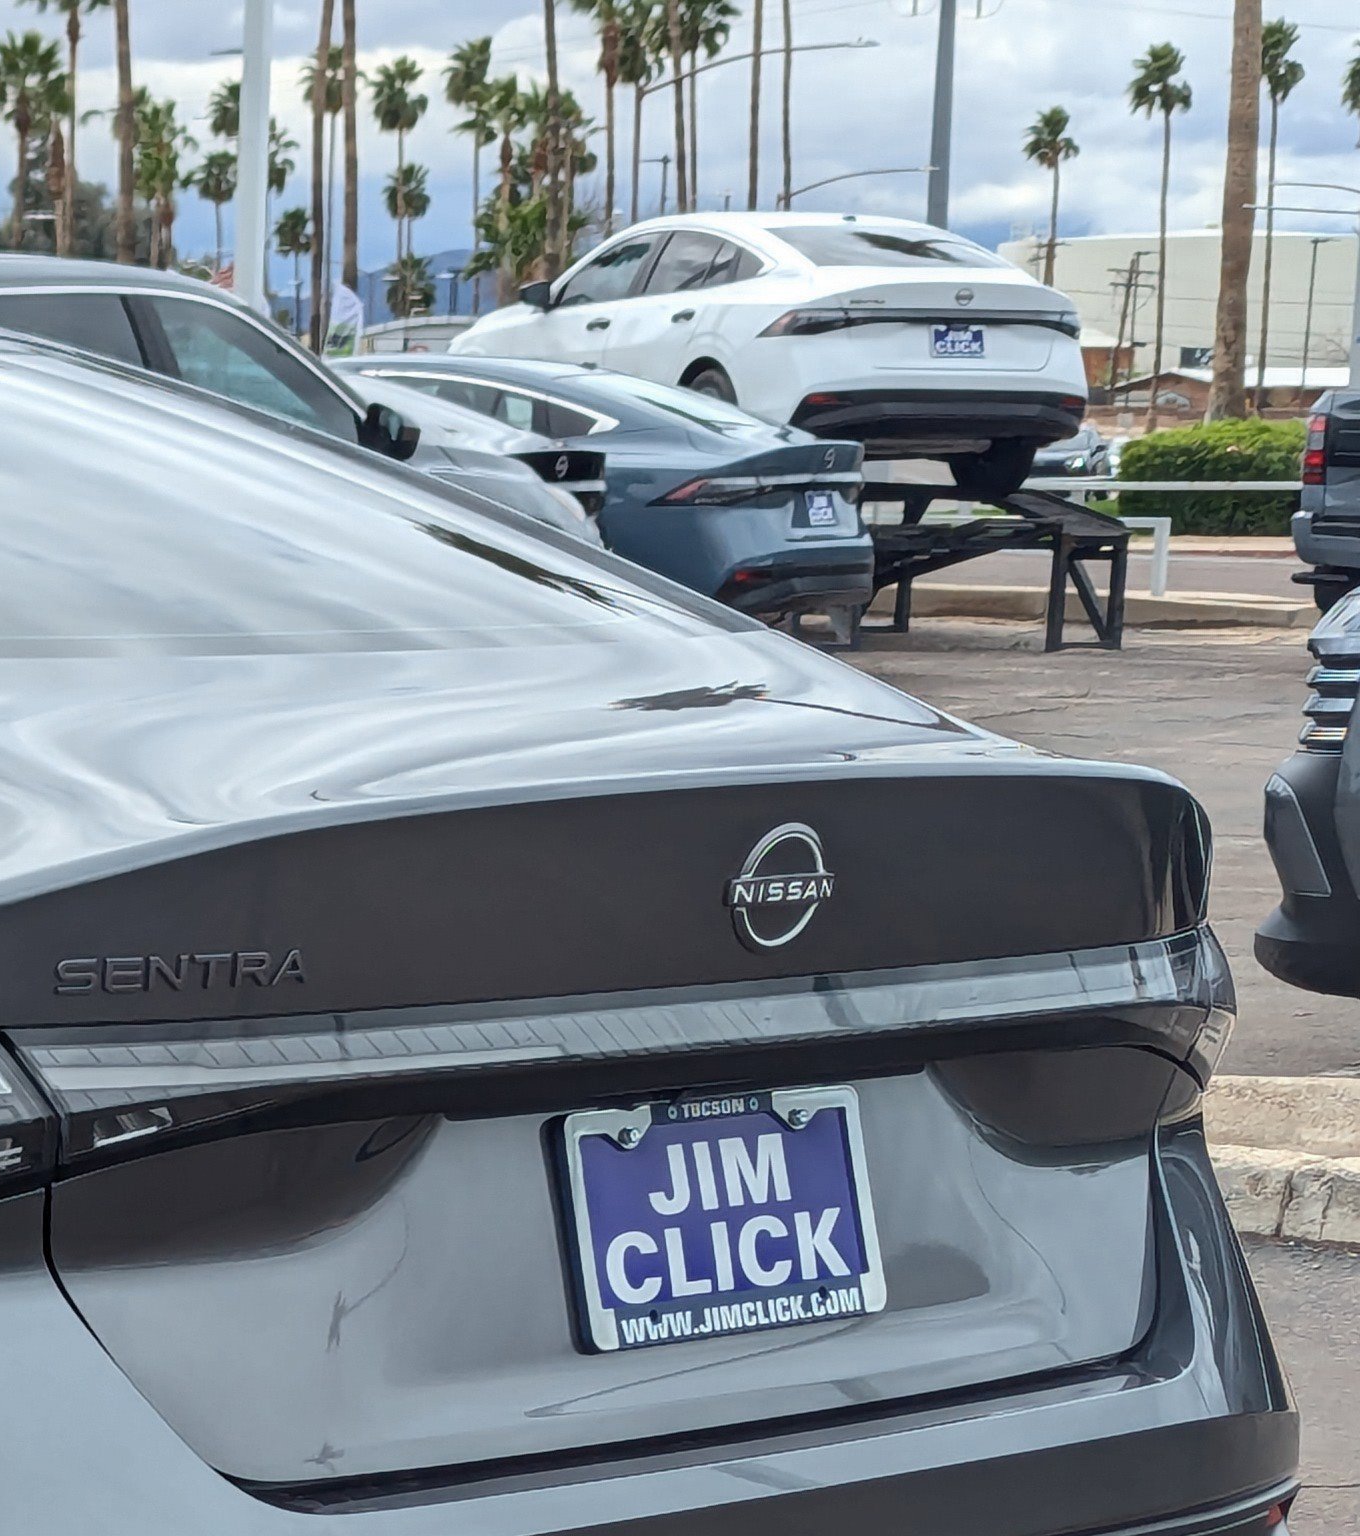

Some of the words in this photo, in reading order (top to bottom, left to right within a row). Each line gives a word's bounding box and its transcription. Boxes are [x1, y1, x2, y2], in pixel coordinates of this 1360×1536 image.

[935, 340, 982, 353] CLICK
[733, 878, 834, 903] NISSAN
[54, 949, 304, 995] SENTRA
[681, 1099, 745, 1119] TUCSON
[648, 1133, 792, 1215] JIM
[605, 1207, 851, 1304] CLICK
[621, 1287, 862, 1344] WWW.JIMCLICK.COM
